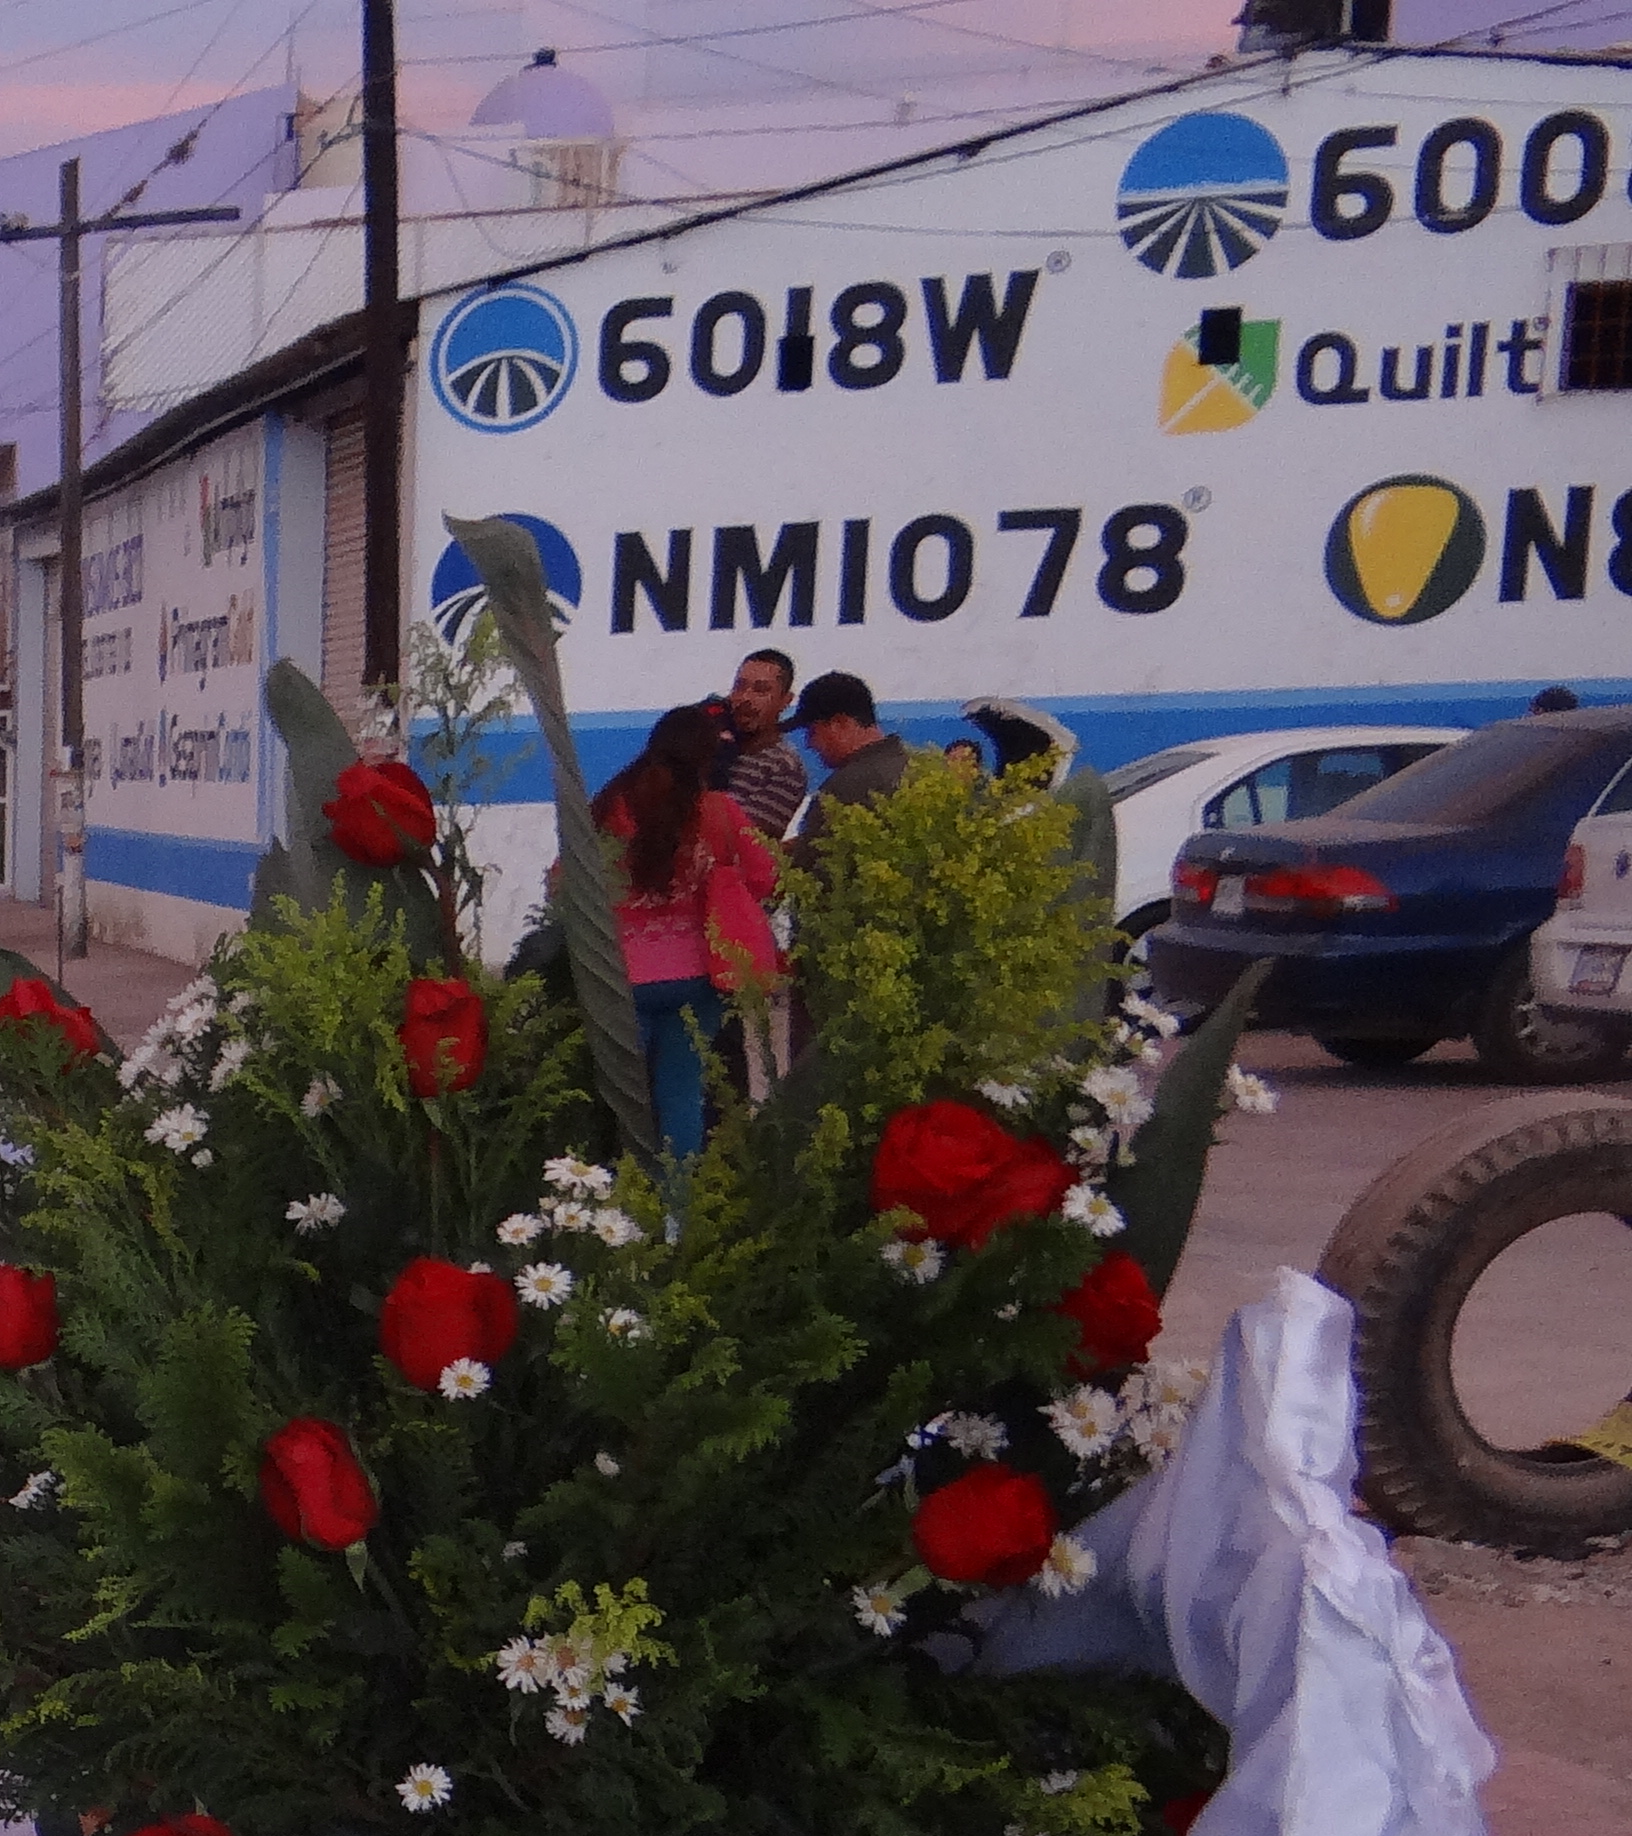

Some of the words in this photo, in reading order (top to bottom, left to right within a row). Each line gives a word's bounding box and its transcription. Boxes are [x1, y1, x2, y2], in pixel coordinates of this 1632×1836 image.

[1310, 108, 1632, 241] 600
[597, 268, 1040, 403] 6018W
[1295, 318, 1545, 405] Quilt
[610, 503, 1190, 635] NM1078
